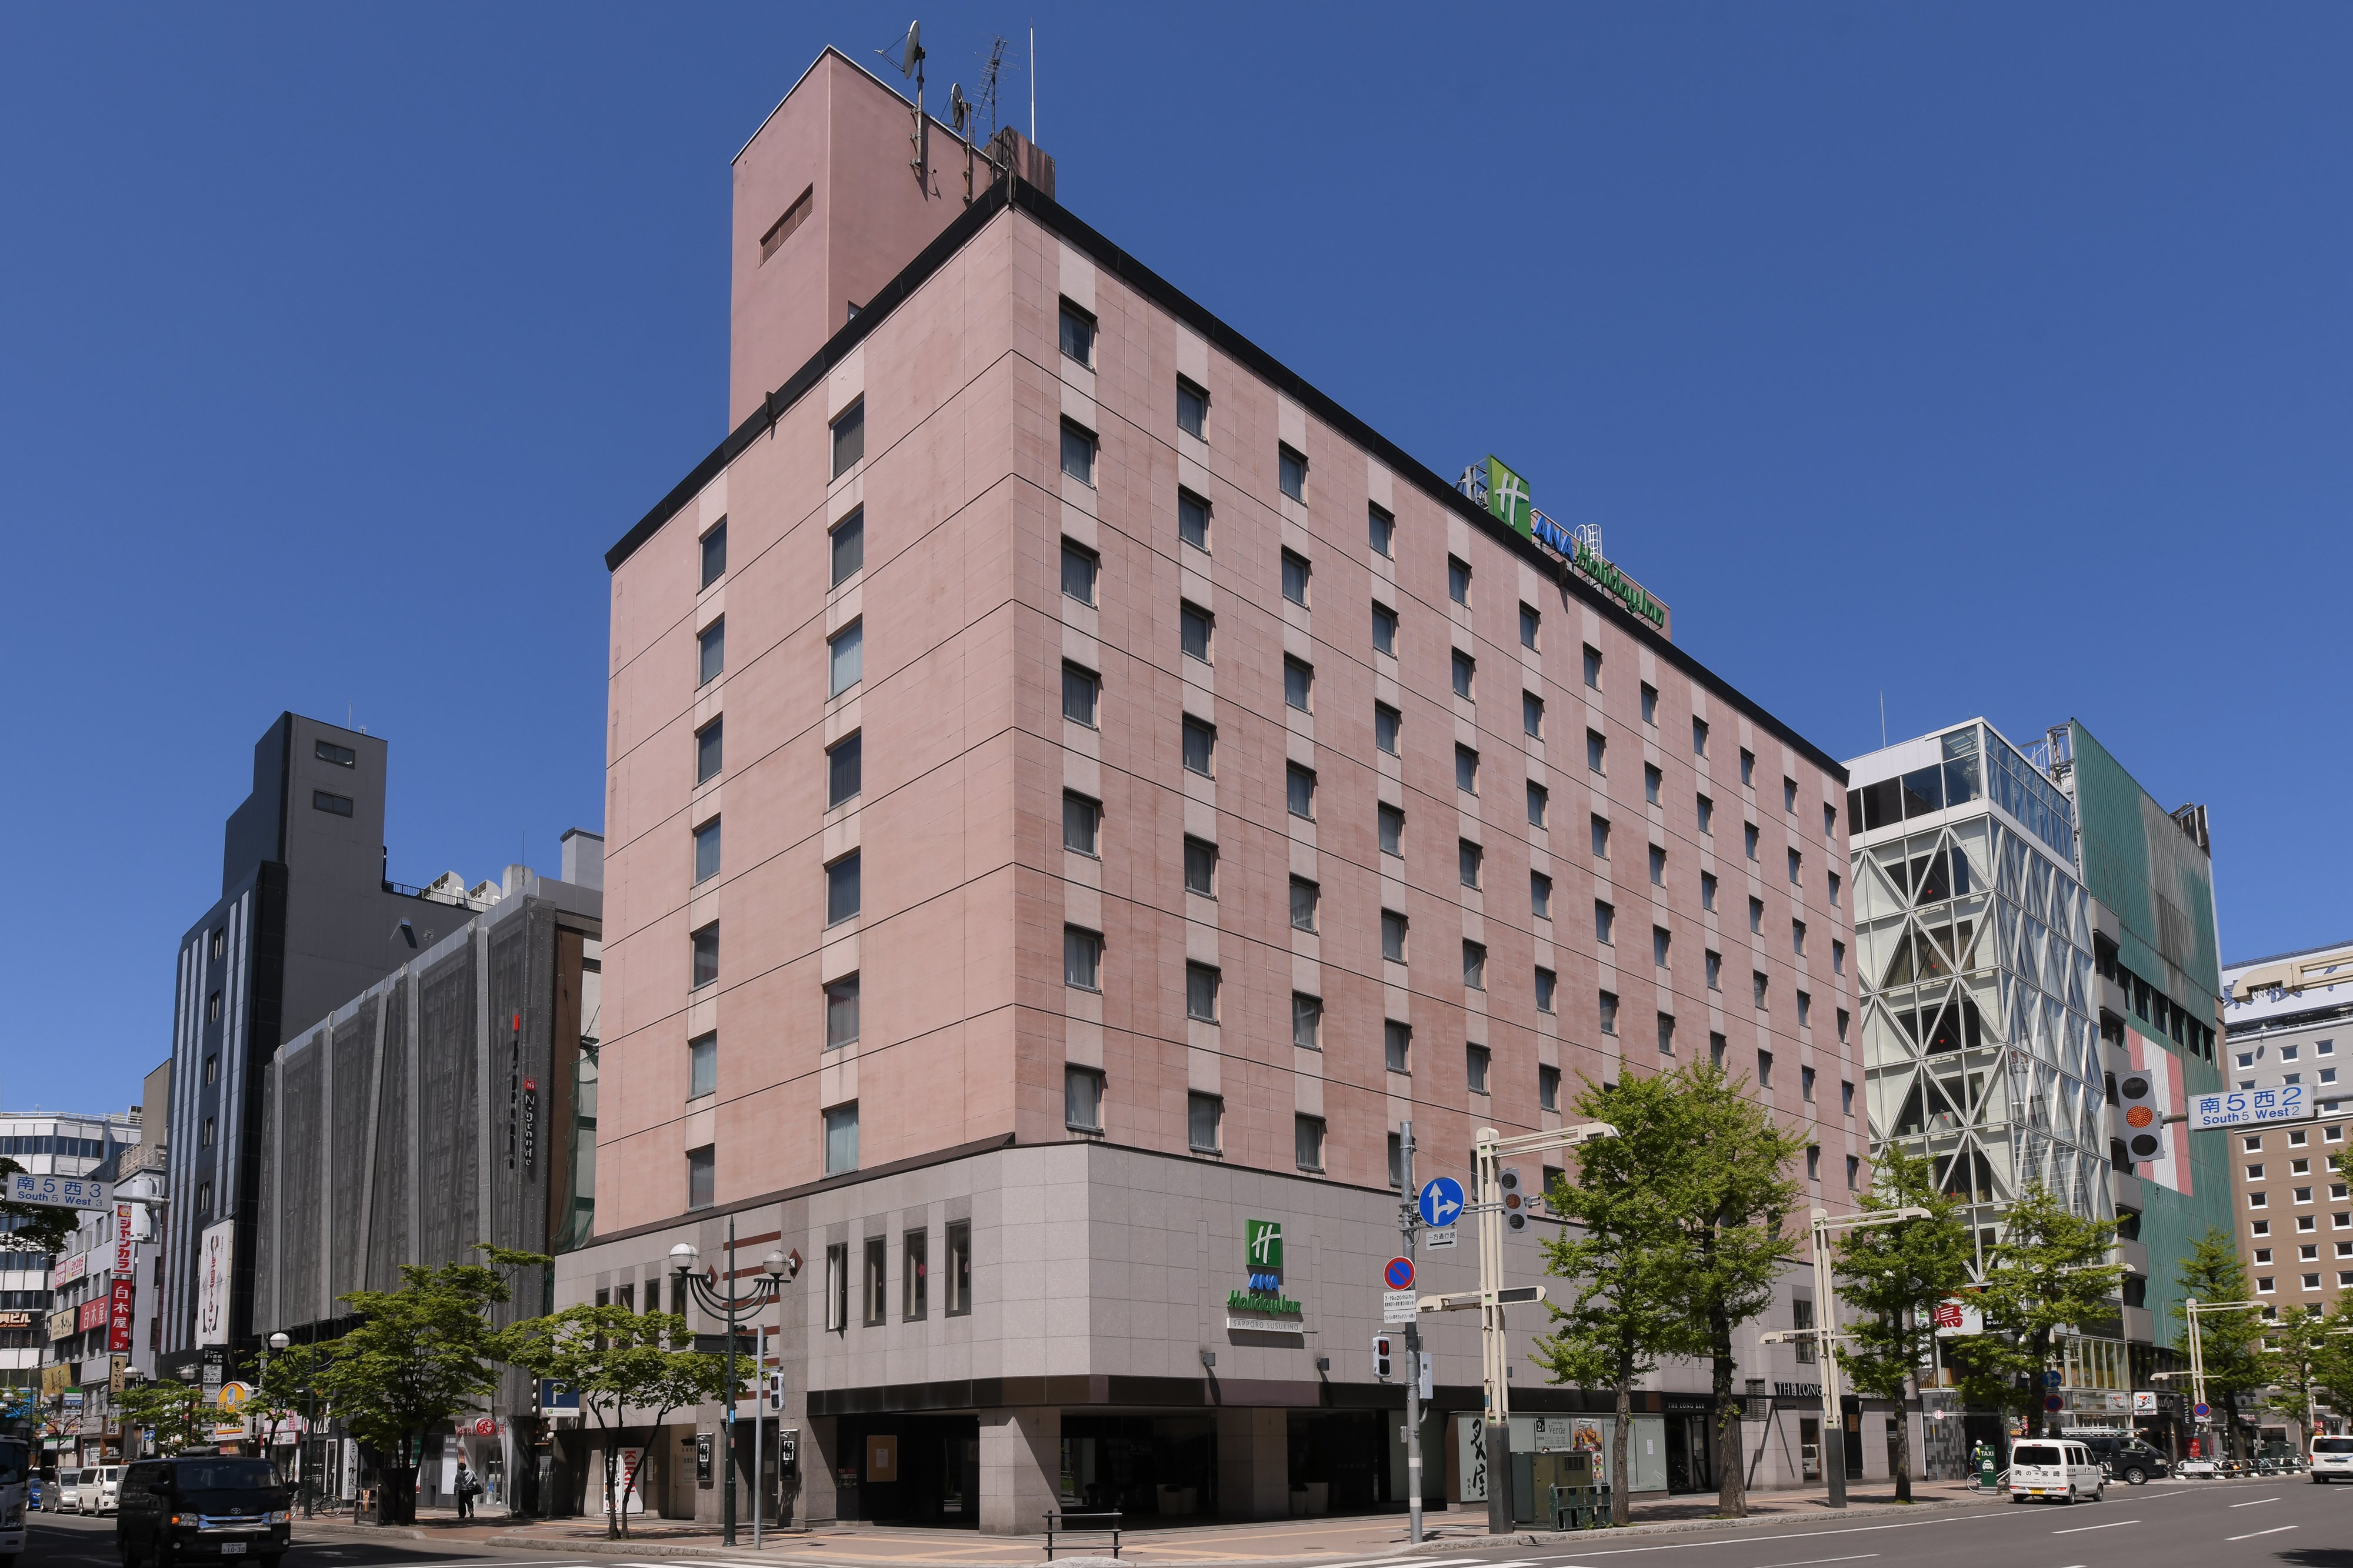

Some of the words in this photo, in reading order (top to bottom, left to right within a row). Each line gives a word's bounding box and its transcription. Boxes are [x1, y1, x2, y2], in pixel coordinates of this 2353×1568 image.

[1532, 515, 1575, 562] ANA
[1576, 541, 1640, 612] Holiday
[1640, 589, 1665, 628] Inn
[2203, 1112, 2239, 1125] South
[2242, 1111, 2249, 1120] 5
[2255, 1107, 2289, 1119] West
[2292, 1106, 2299, 1116] 2
[18, 1191, 48, 1202] South
[65, 1196, 91, 1206] West
[118, 1219, 131, 1269] ジャンカラ
[1248, 1273, 1279, 1291] ANA
[84, 1302, 105, 1329] 白木屋
[113, 1285, 129, 1329] 白木屋
[1227, 1290, 1280, 1316] Holiday
[1279, 1295, 1302, 1314] Inn
[1233, 1320, 1264, 1329] SAPPORO
[1267, 1322, 1299, 1330] SUSUKINO
[1777, 1382, 1797, 1396] THE
[1798, 1383, 1822, 1397] LONG
[1537, 1422, 1545, 1432] 2F
[1548, 1424, 1566, 1434] Verde
[624, 1450, 636, 1493] KIRIN
